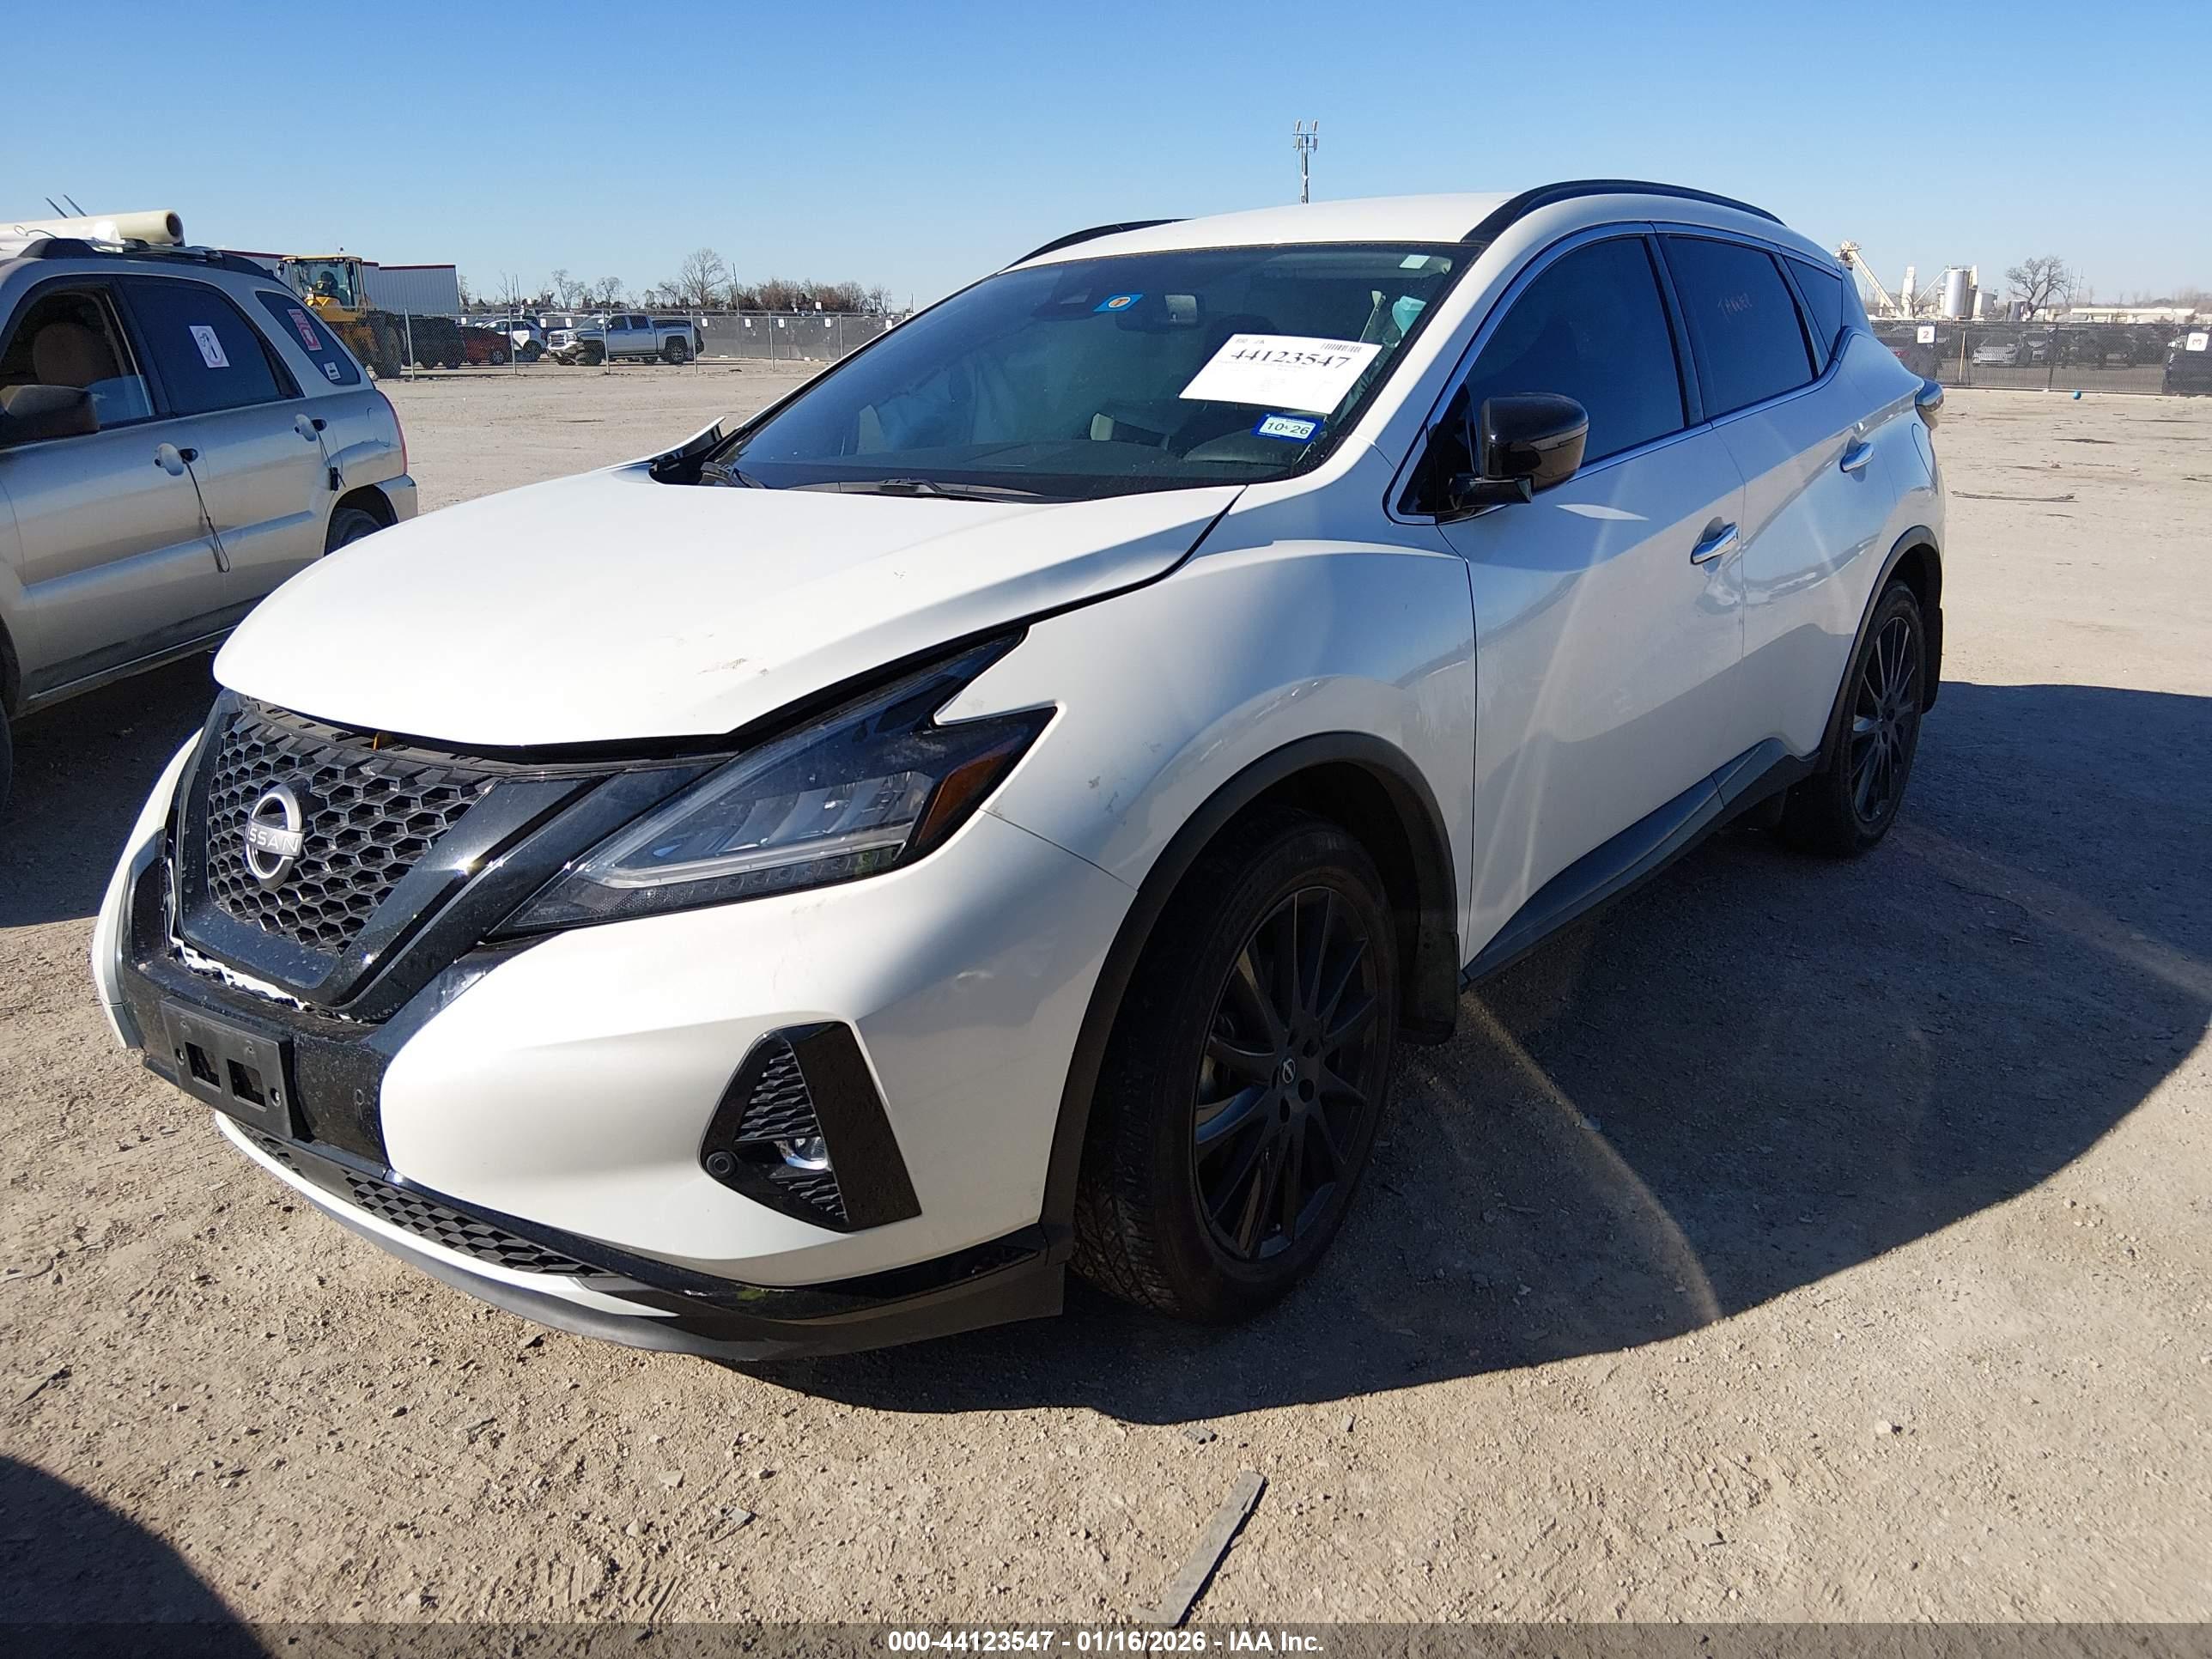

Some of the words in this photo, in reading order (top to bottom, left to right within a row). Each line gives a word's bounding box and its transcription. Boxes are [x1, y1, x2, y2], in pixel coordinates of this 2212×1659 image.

[1923, 331, 1929, 339] 2
[1230, 348, 1352, 369] 44123547
[1267, 422, 1285, 431] 10
[1290, 425, 1310, 434] 26
